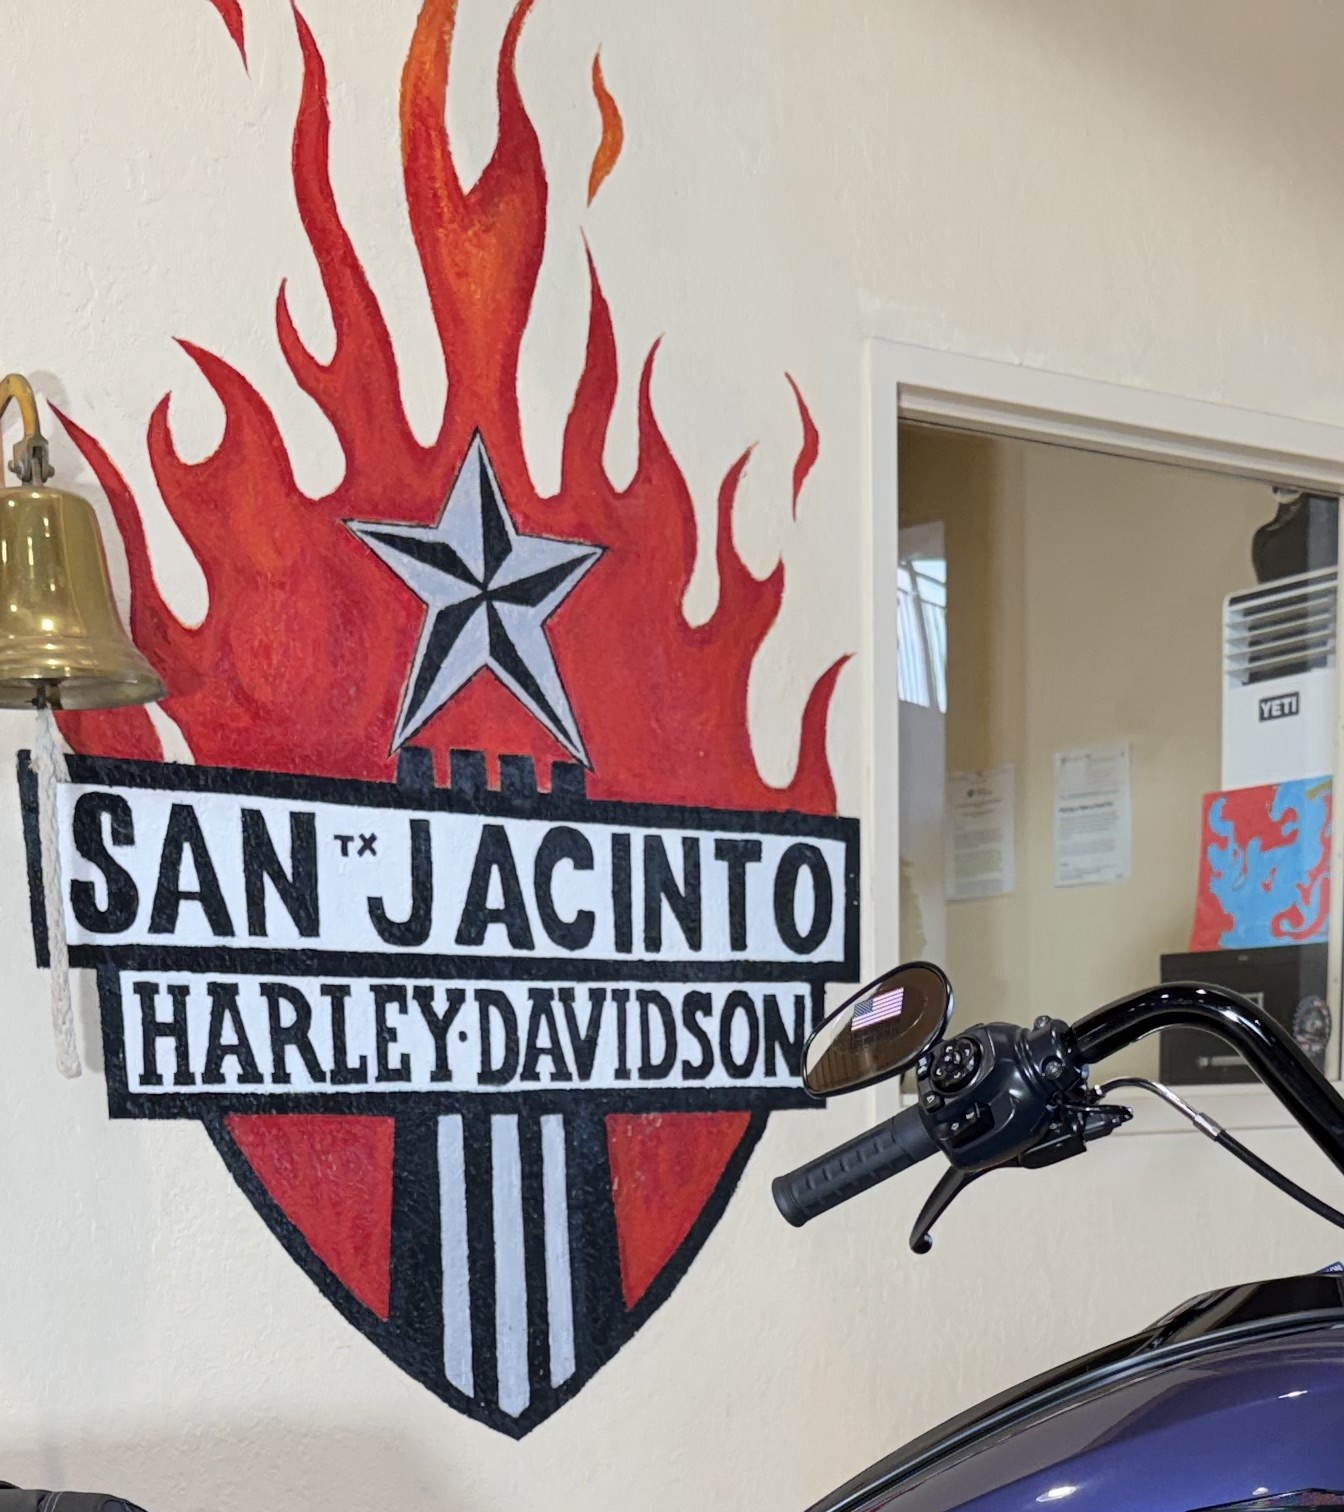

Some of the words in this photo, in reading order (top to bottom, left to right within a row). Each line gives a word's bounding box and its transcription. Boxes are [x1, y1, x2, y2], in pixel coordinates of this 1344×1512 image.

[1260, 695, 1297, 719] YETI
[70, 791, 321, 938] SAN
[334, 832, 378, 858] TX
[367, 818, 833, 956] JACINTO
